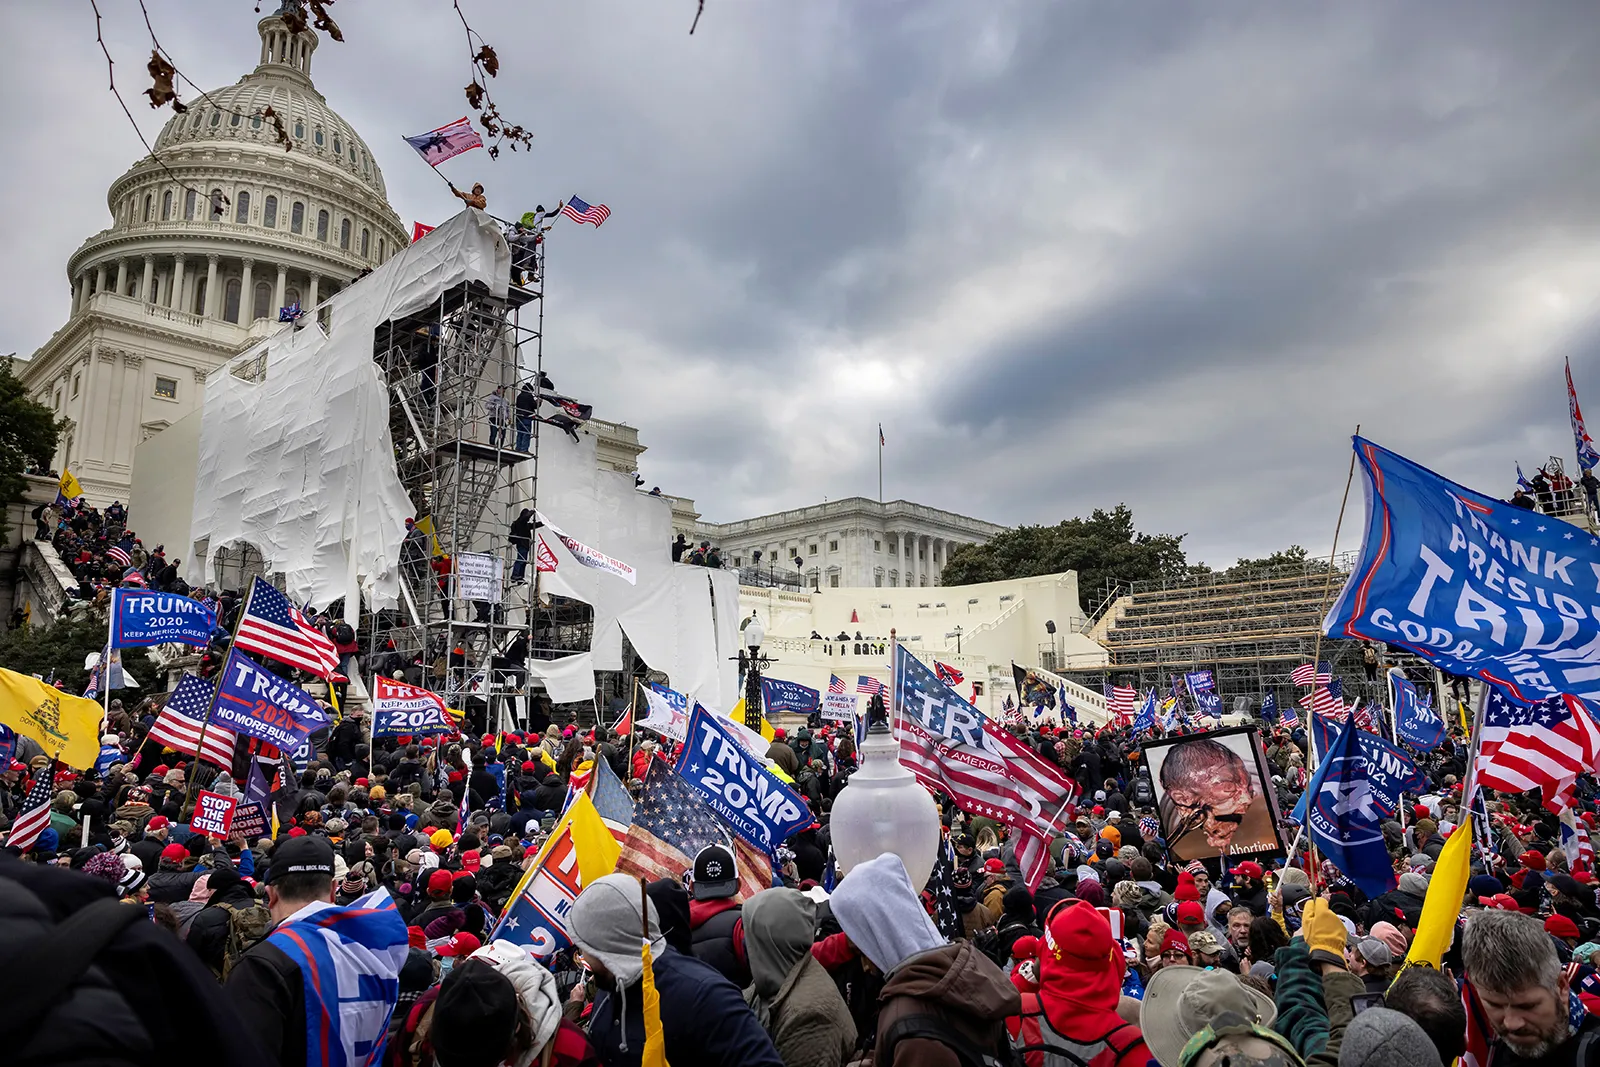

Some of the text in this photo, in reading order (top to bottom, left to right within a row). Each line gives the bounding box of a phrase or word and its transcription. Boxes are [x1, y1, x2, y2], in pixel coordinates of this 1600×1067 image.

[586, 547, 604, 560] FOR
[605, 556, 633, 574] TRUMP
[145, 628, 180, 638] AMERICA
[1370, 607, 1453, 648] GOD
[235, 661, 326, 722] TRUMP
[381, 701, 403, 709] KEEP
[217, 706, 235, 720] NO
[234, 714, 268, 733] MORE
[47, 738, 56, 746] ON
[57, 741, 67, 751] ME
[909, 724, 1007, 777] MAKING AMERICA
[277, 765, 287, 787] FOR
[700, 720, 801, 825] TRUMP
[201, 795, 232, 811] STOP
[203, 807, 225, 822] THE
[193, 816, 227, 835] STEAL
[708, 798, 757, 838] AMERICA
[1311, 806, 1337, 834] FIRST
[1229, 840, 1276, 856] Abortion
